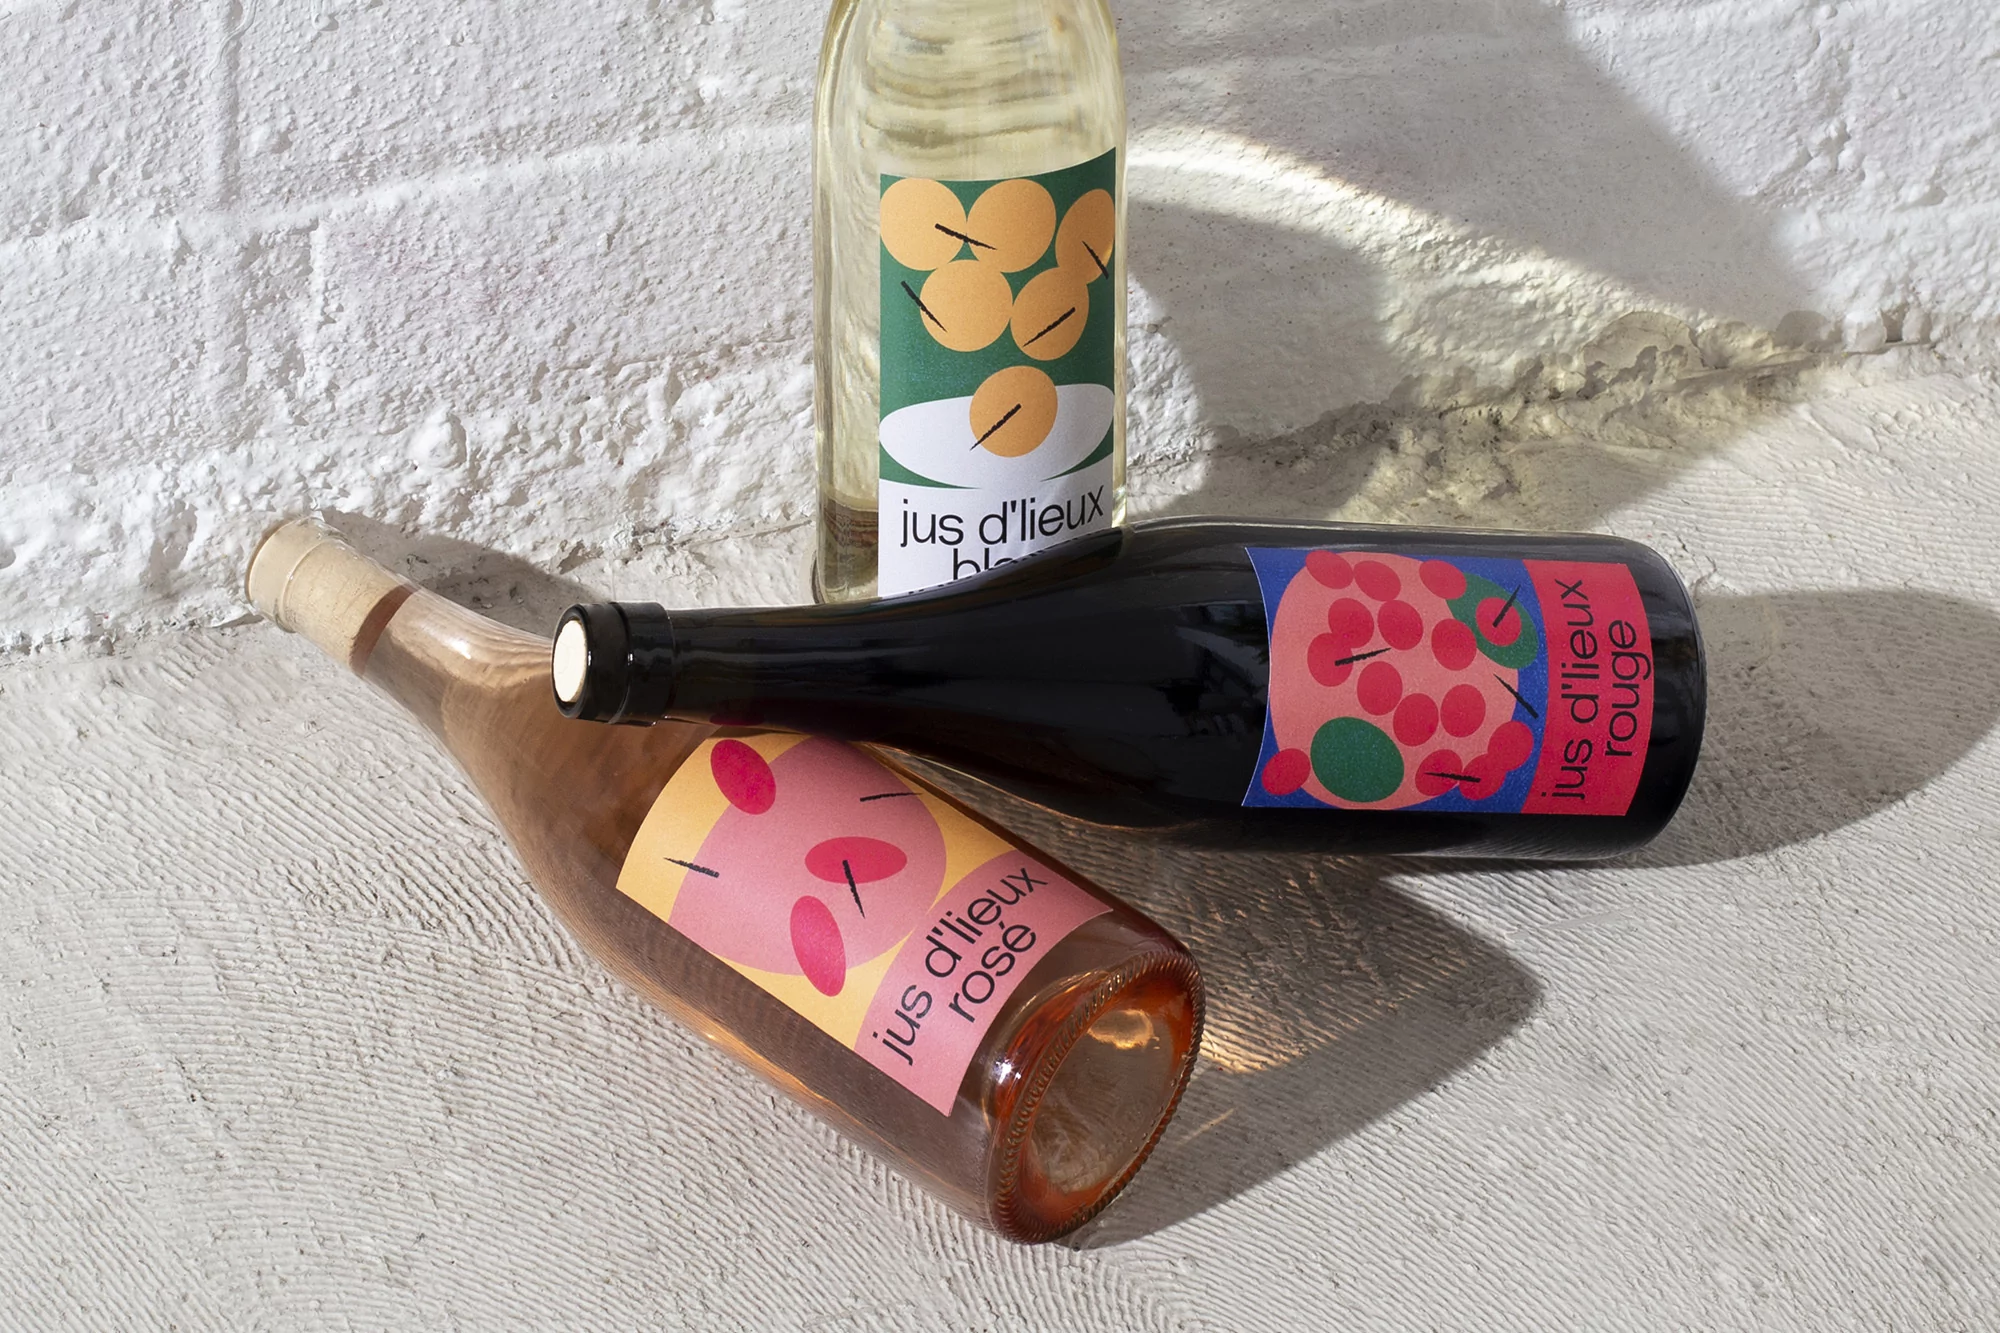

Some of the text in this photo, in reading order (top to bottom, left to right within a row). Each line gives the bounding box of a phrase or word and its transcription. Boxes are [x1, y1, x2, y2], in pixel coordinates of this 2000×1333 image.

[900, 485, 1104, 547] jus d'lieux
[1541, 579, 1600, 800] jus d'lieux
[1604, 619, 1652, 757] rouge
[872, 867, 1048, 1066] jus d'lieux
[948, 921, 1036, 1023] rosé
